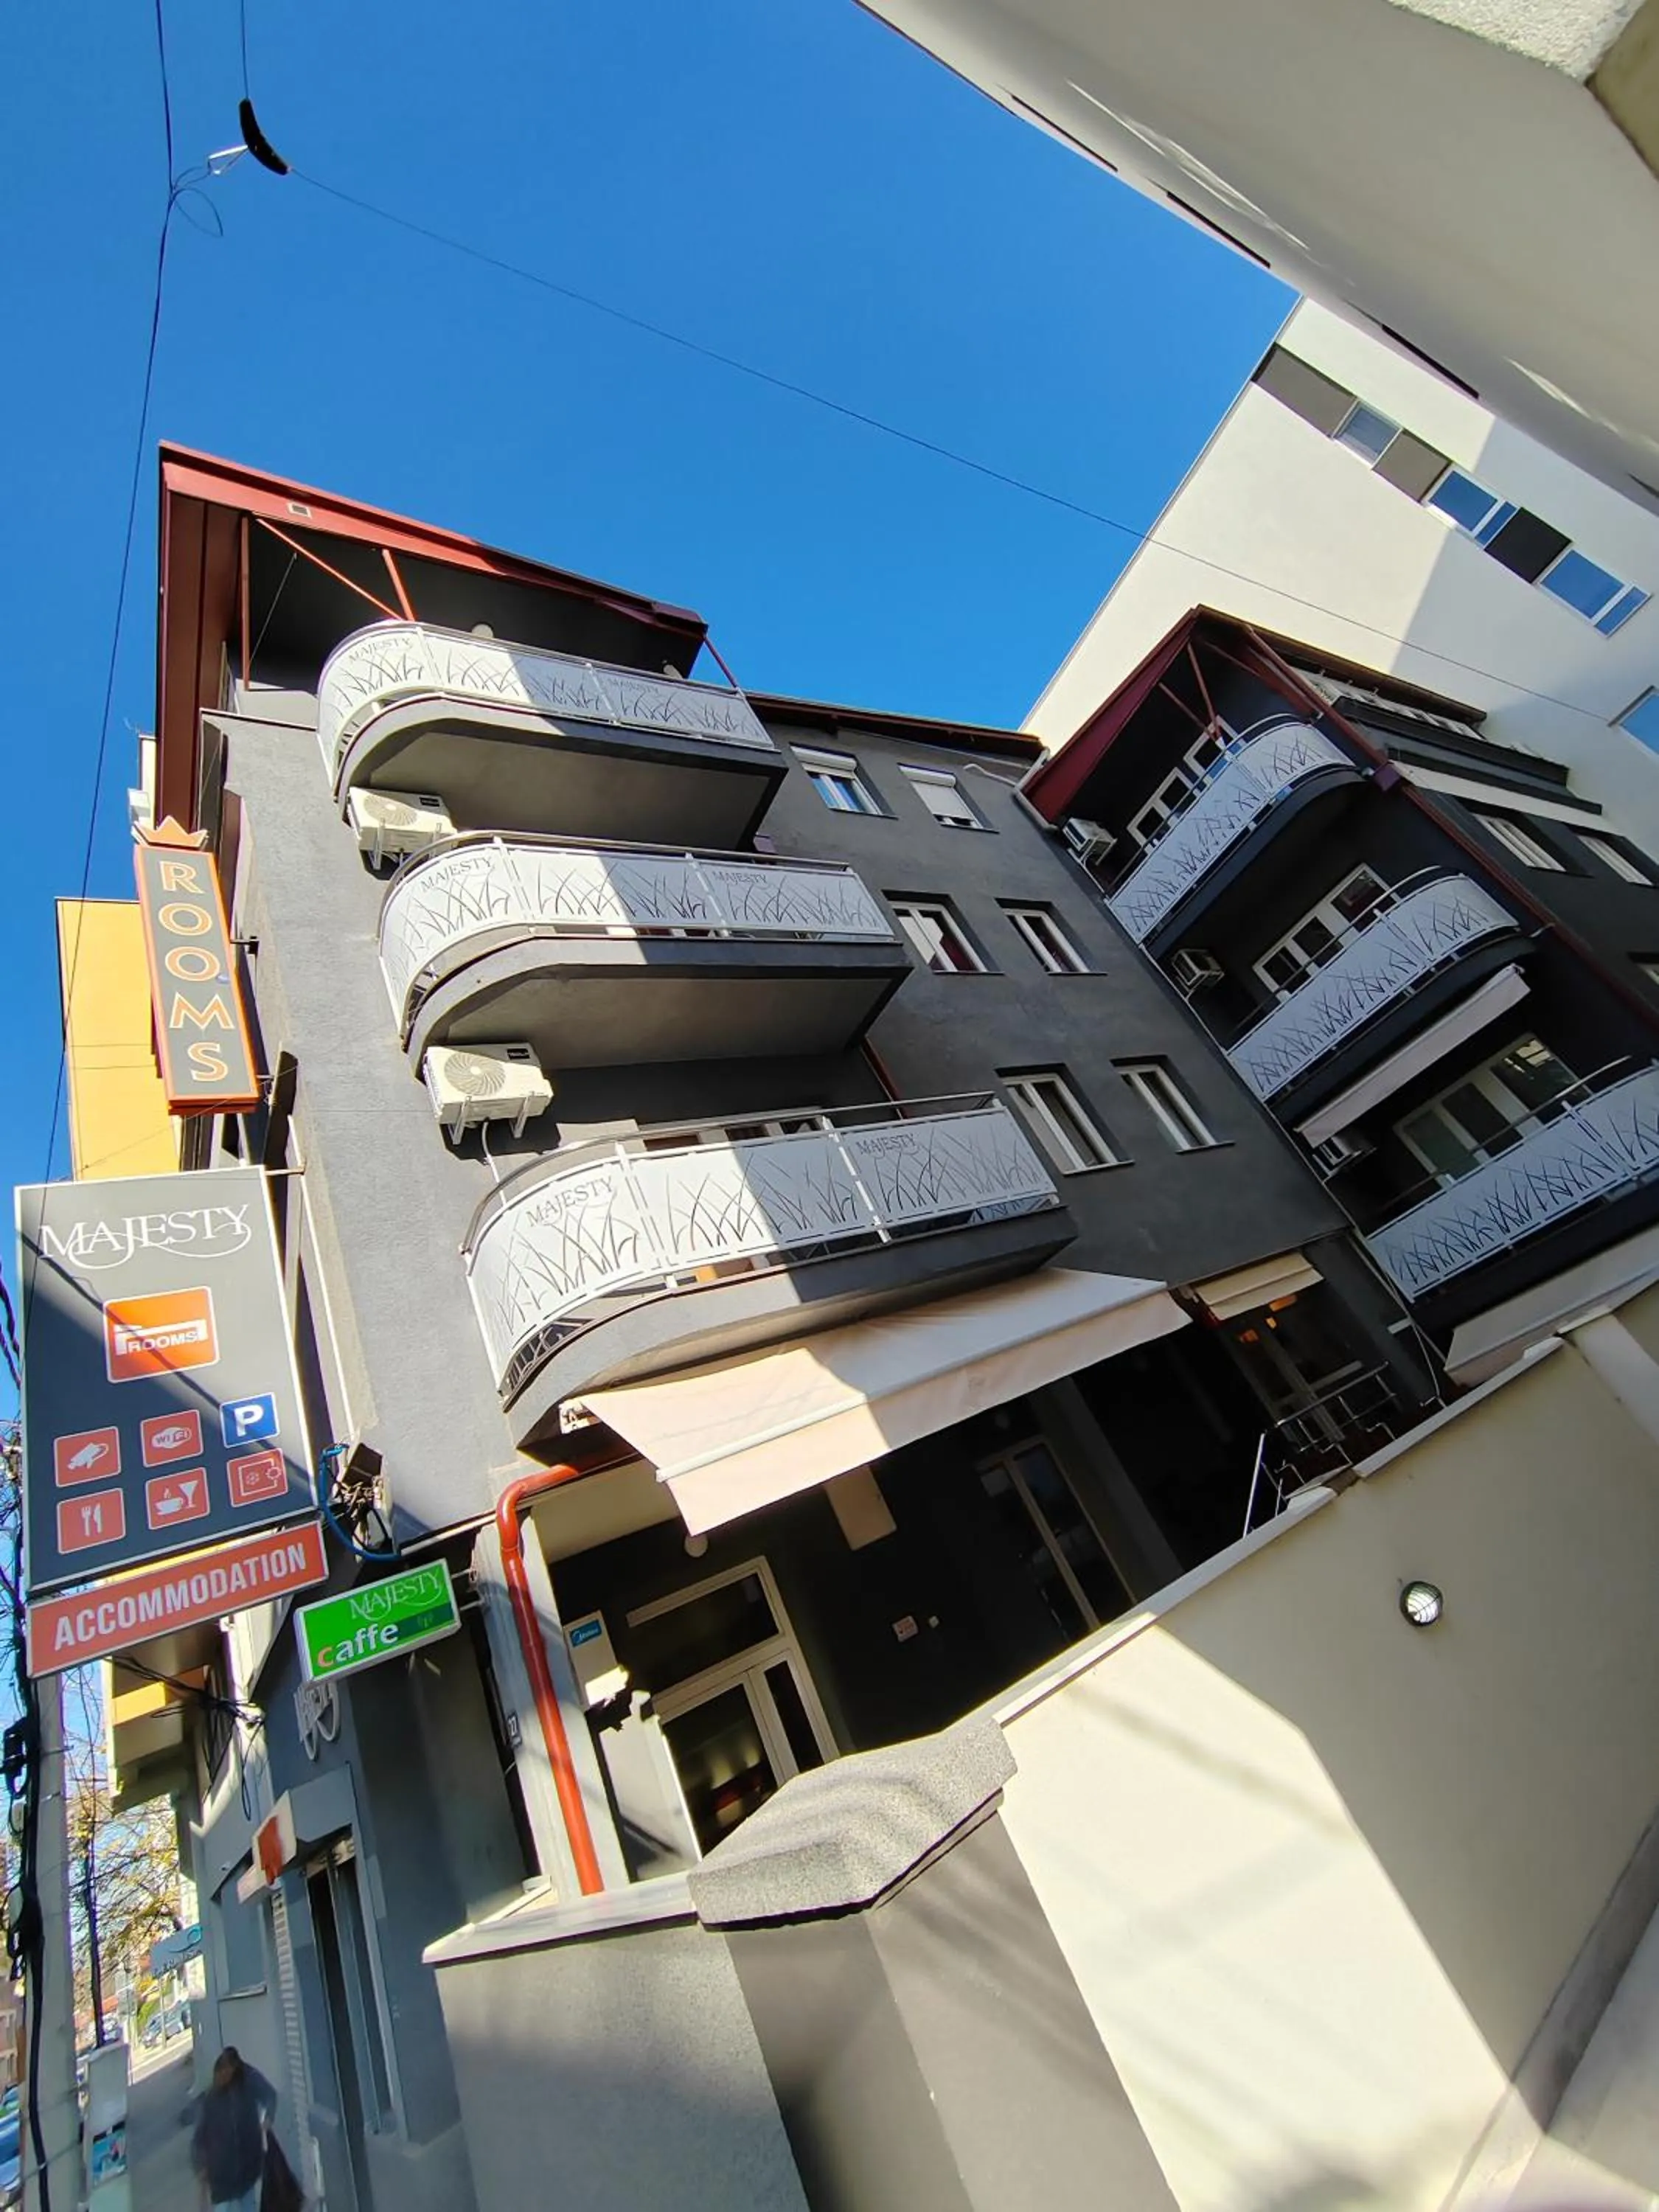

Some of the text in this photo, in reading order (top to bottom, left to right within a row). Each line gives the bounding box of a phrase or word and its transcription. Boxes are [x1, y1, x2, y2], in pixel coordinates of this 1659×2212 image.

[420, 856, 494, 893] MAJESTY
[158, 860, 235, 1082] ROOMS
[855, 1133, 919, 1159] MAJESTY
[526, 1175, 617, 1227] MAJESTY
[39, 1204, 251, 1269] MAJESTY
[128, 1330, 199, 1354] ROOMS
[234, 1405, 263, 1437] P
[55, 1543, 307, 1651] ACCOMMODATION
[349, 1566, 442, 1621] MAJESTY
[317, 1623, 399, 1667] caffe
